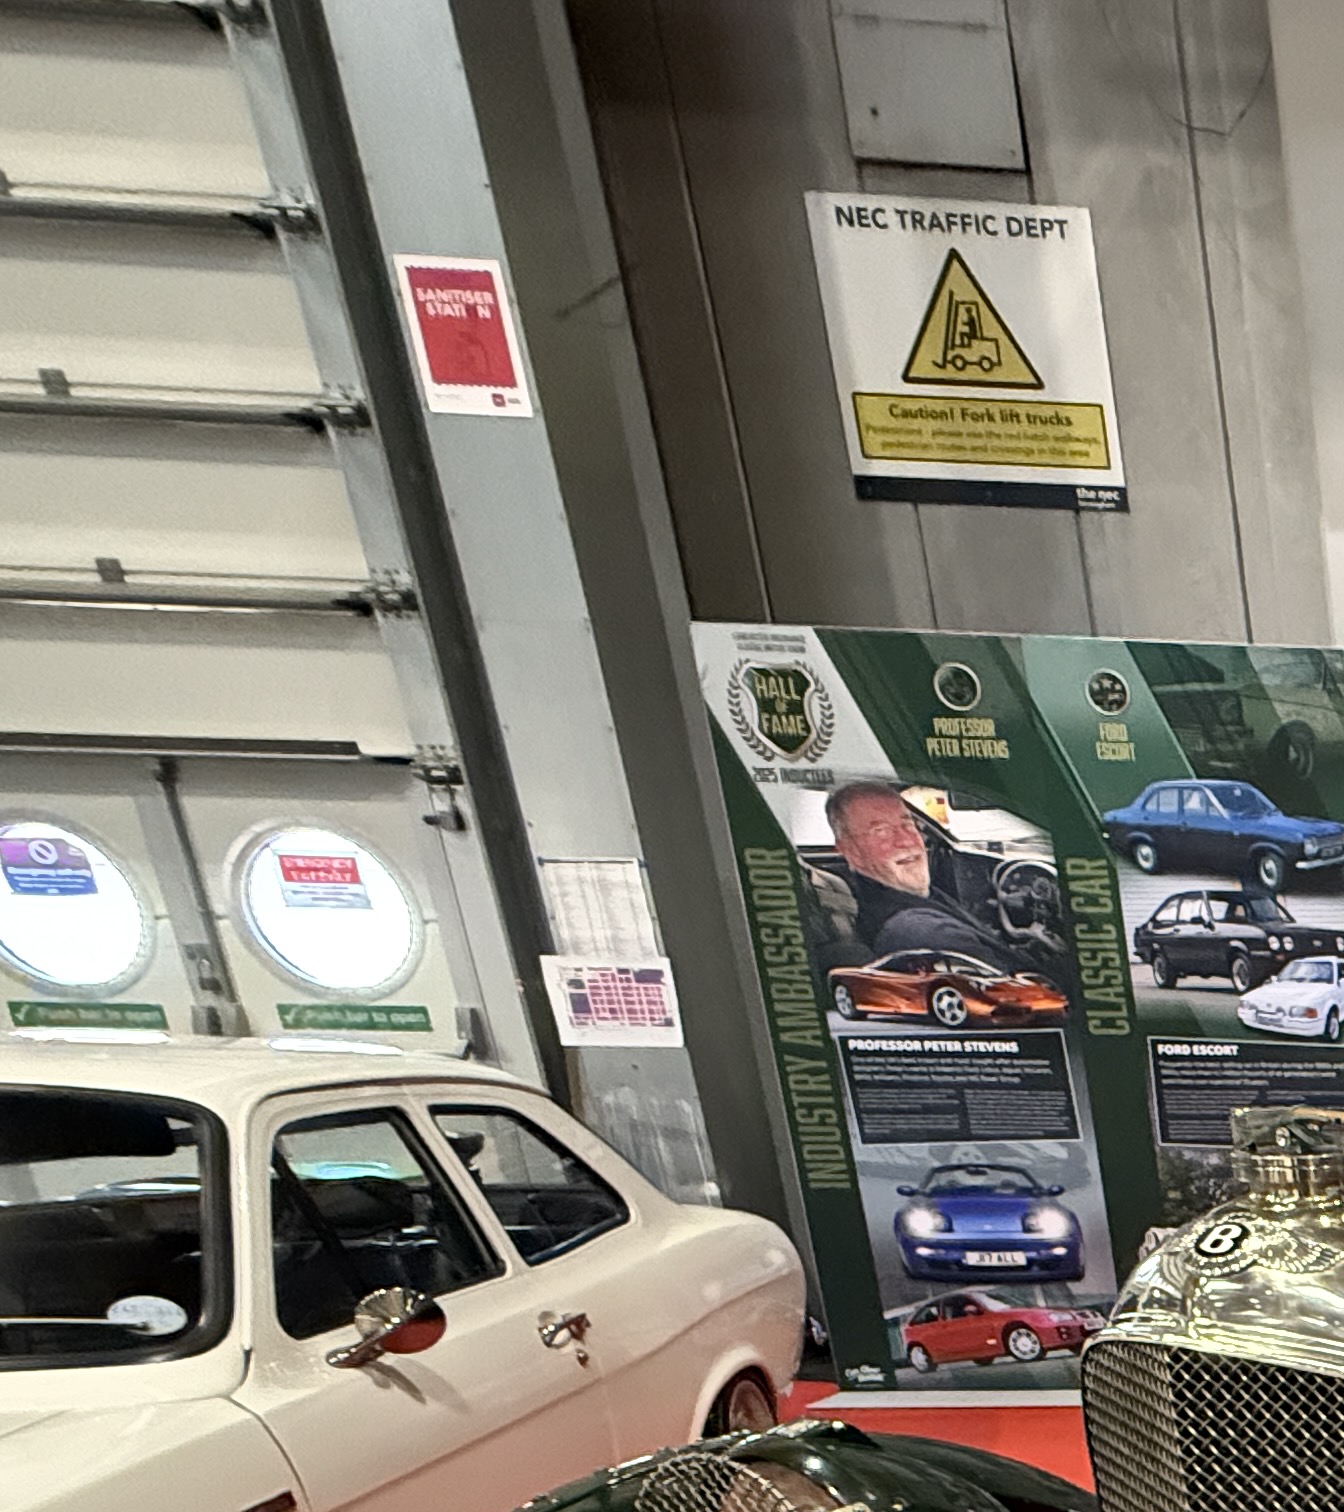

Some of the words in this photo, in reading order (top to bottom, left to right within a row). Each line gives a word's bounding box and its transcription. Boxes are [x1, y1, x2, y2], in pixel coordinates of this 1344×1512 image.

[834, 205, 888, 230] NEC
[894, 208, 999, 236] TRAFFIC
[1005, 216, 1069, 240] DEPT
[416, 287, 494, 305] SANITISER
[425, 301, 491, 319] STATIN
[889, 403, 954, 423] Caution!
[961, 408, 996, 424] Fork
[1000, 409, 1021, 425] lift
[1025, 411, 1073, 428] trucks
[1076, 487, 1096, 499] the
[754, 674, 802, 701] HALL
[760, 712, 807, 737] FAME
[932, 717, 996, 737] PROFESSOR
[1098, 722, 1128, 742] FORD
[926, 737, 959, 759] PETER
[961, 739, 1009, 760] STEVENS
[1095, 741, 1135, 762] ESCORT
[1065, 857, 1114, 914] CAR
[743, 847, 825, 1050] AMBASSADOR
[1074, 923, 1131, 1036] CLASSIC
[847, 1038, 922, 1052] PROFESSOR
[924, 1040, 962, 1053] PETER
[964, 1041, 1020, 1054] STEVENS
[1157, 1043, 1191, 1056] FORD
[1192, 1044, 1239, 1057] ESCORT
[783, 1052, 851, 1191] INDUSTRY
[1199, 1224, 1242, 1254] B
